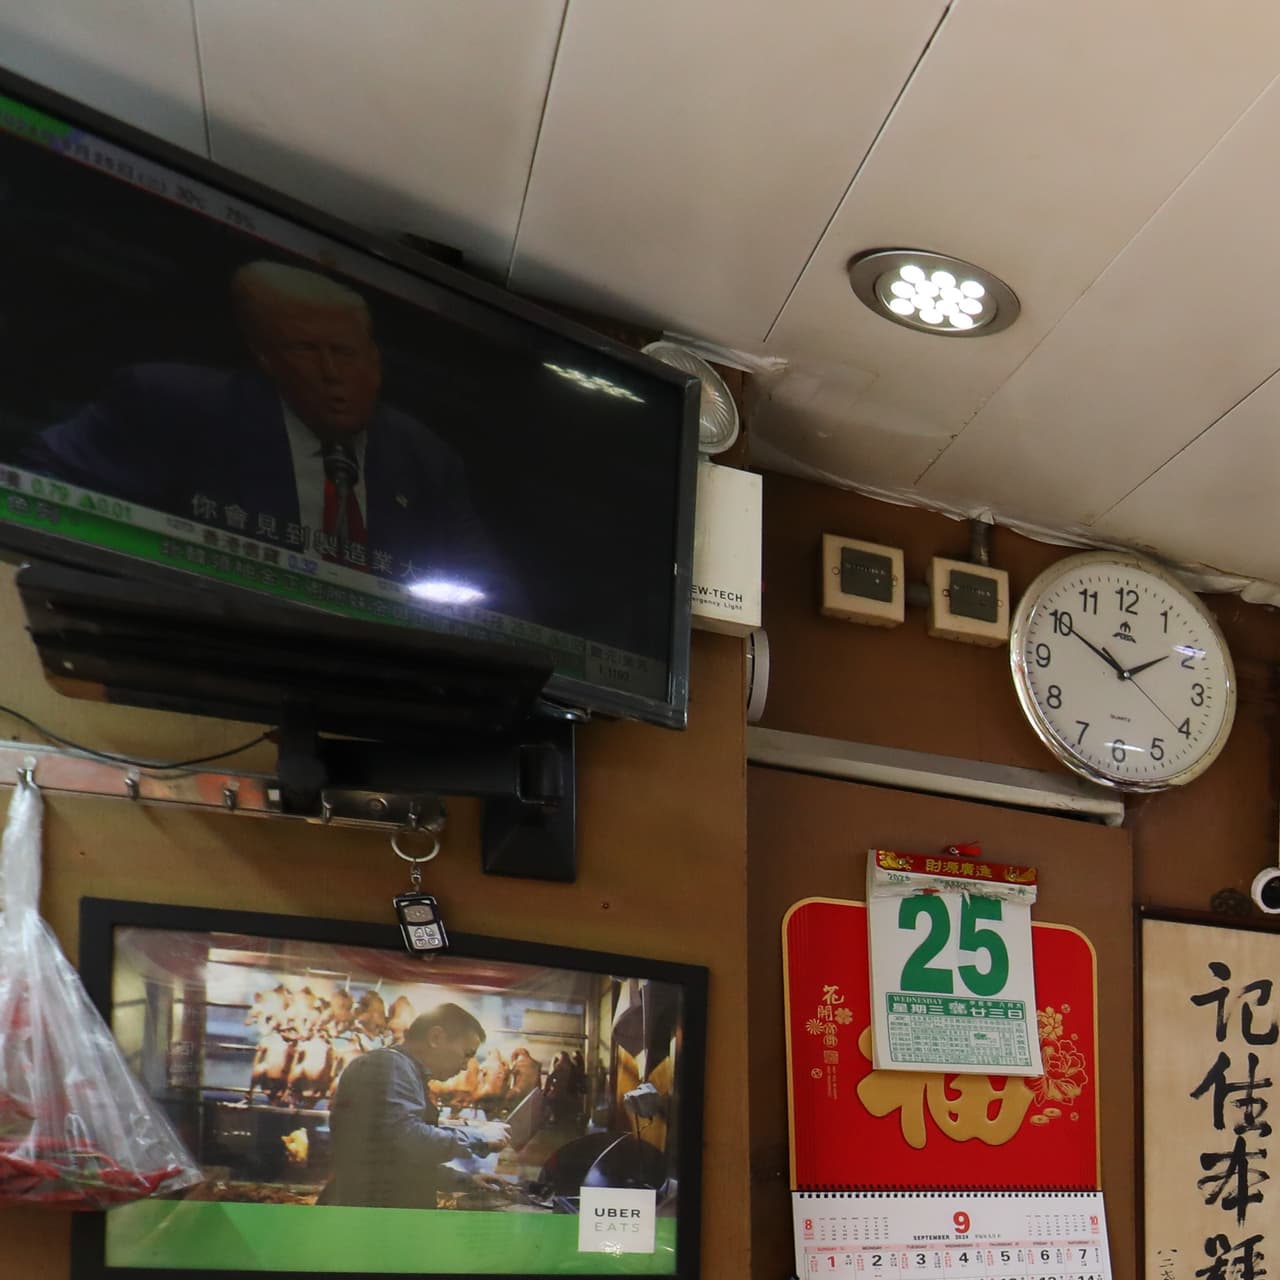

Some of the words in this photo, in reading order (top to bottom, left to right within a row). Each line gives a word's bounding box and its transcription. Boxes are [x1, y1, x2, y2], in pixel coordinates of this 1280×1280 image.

[1079, 588, 1098, 615] 11
[1115, 587, 1139, 615] 12
[1049, 609, 1072, 636] 10
[1160, 610, 1168, 633] 1
[1036, 643, 1051, 668] 9
[1046, 684, 1062, 709] 8
[1190, 683, 1204, 706] 3
[1076, 720, 1089, 745] 7
[1177, 717, 1191, 739] 4
[1112, 739, 1126, 763] 6
[1150, 737, 1165, 761] 5
[898, 893, 1009, 997] 25
[892, 1002, 944, 1015] 星期三
[893, 995, 942, 1005] WEDNESDAY
[594, 1207, 641, 1219] UBER
[805, 1219, 812, 1230] 8
[953, 1211, 971, 1234] 9
[594, 1222, 640, 1233] EATS
[828, 1256, 834, 1267] 1
[872, 1255, 882, 1266] 2
[917, 1254, 925, 1264] 3
[959, 1253, 968, 1263] 4
[1001, 1251, 1010, 1261] 5
[1041, 1250, 1049, 1260] 6
[1079, 1249, 1086, 1259] 7
